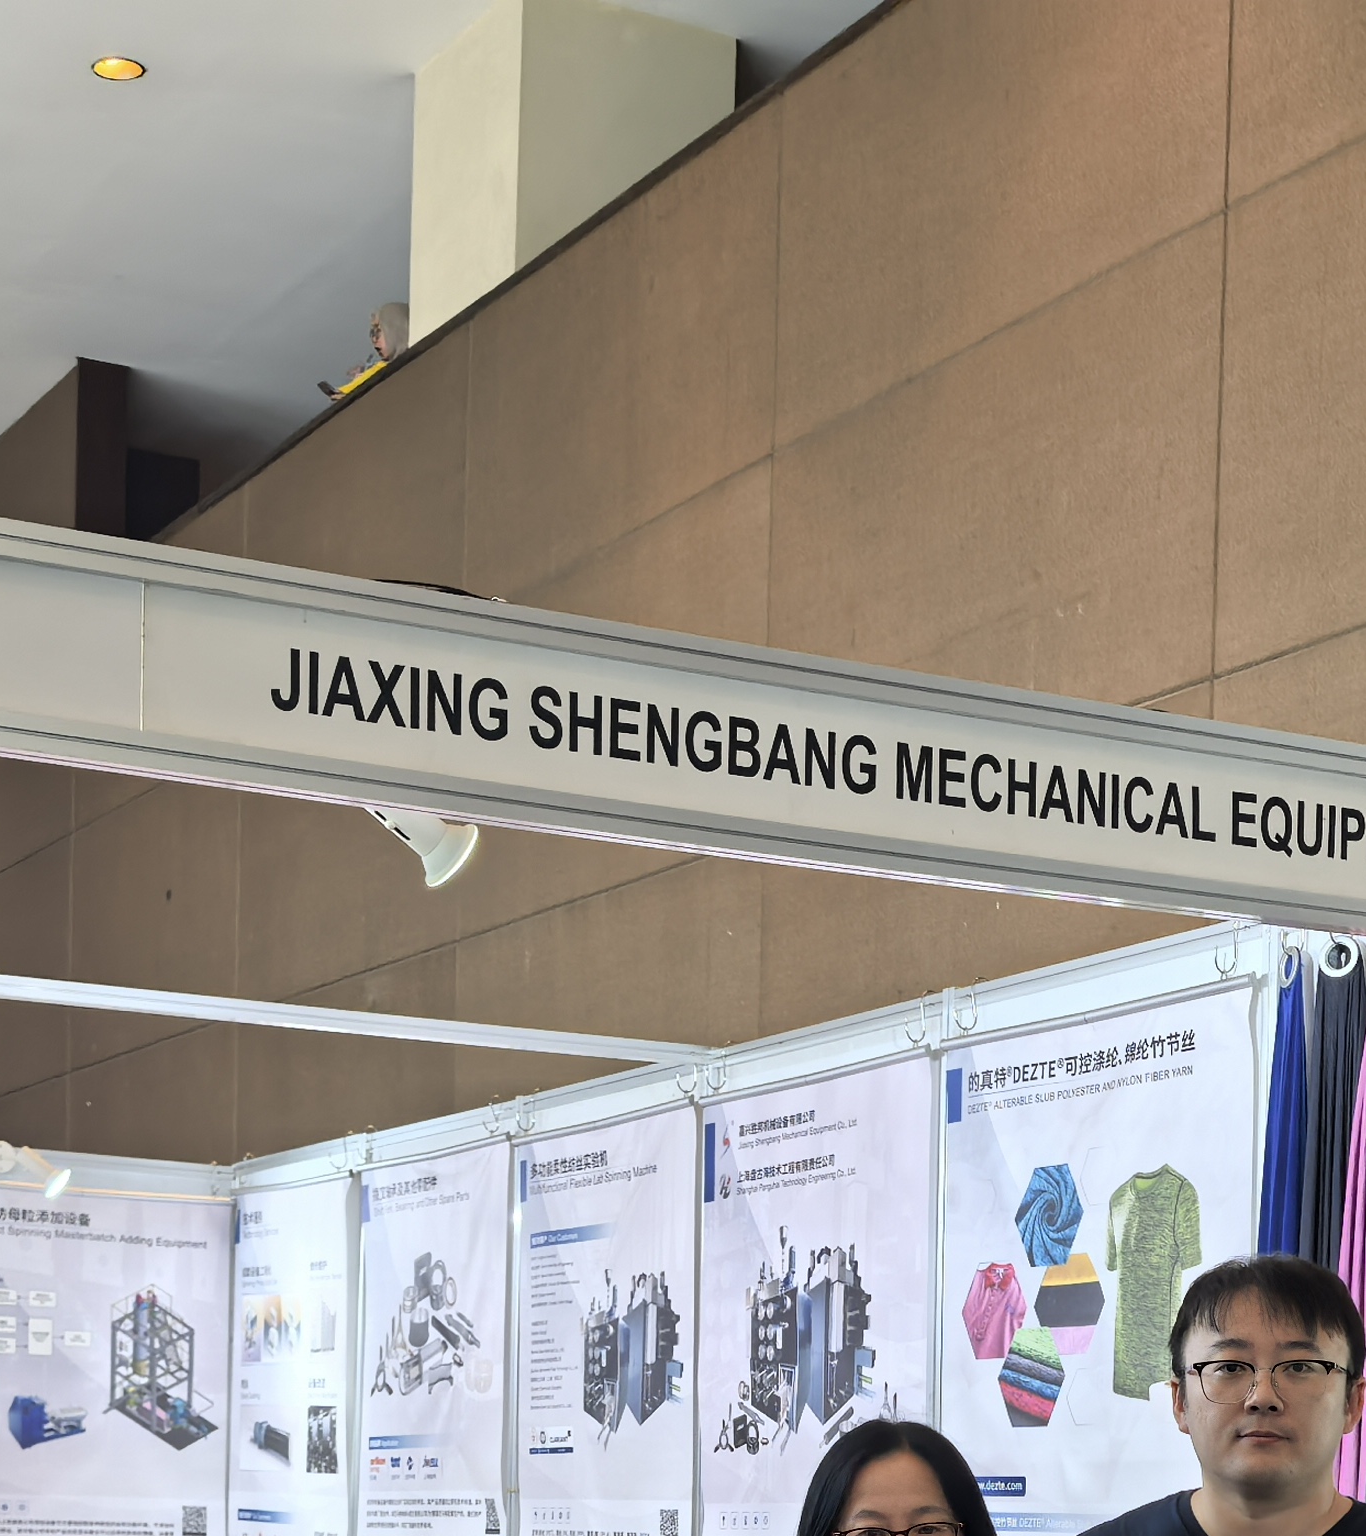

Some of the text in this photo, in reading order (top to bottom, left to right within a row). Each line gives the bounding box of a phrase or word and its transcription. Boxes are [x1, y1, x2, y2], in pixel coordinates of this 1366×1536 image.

[270, 648, 508, 741] JIAXING
[528, 686, 877, 795] SHENGBANG
[896, 741, 1216, 843] MECHANICAL
[993, 1095, 1033, 1111] ALTERABLE
[1035, 1091, 1055, 1103] SLUB
[1057, 1084, 1101, 1101] POLYESTER
[1101, 1081, 1116, 1092] AND
[1117, 1075, 1143, 1090] NYLON
[1145, 1070, 1170, 1084] FIBER
[1172, 1065, 1194, 1079] YARN
[809, 1123, 837, 1136] Equipment
[605, 1168, 631, 1183] Spinning
[633, 1164, 658, 1177] Machine
[781, 1175, 808, 1188] Technology
[808, 1171, 836, 1184] Engineering
[7, 1226, 52, 1240] Spinning
[119, 1233, 154, 1247] Adding
[155, 1236, 208, 1251] Equipment
